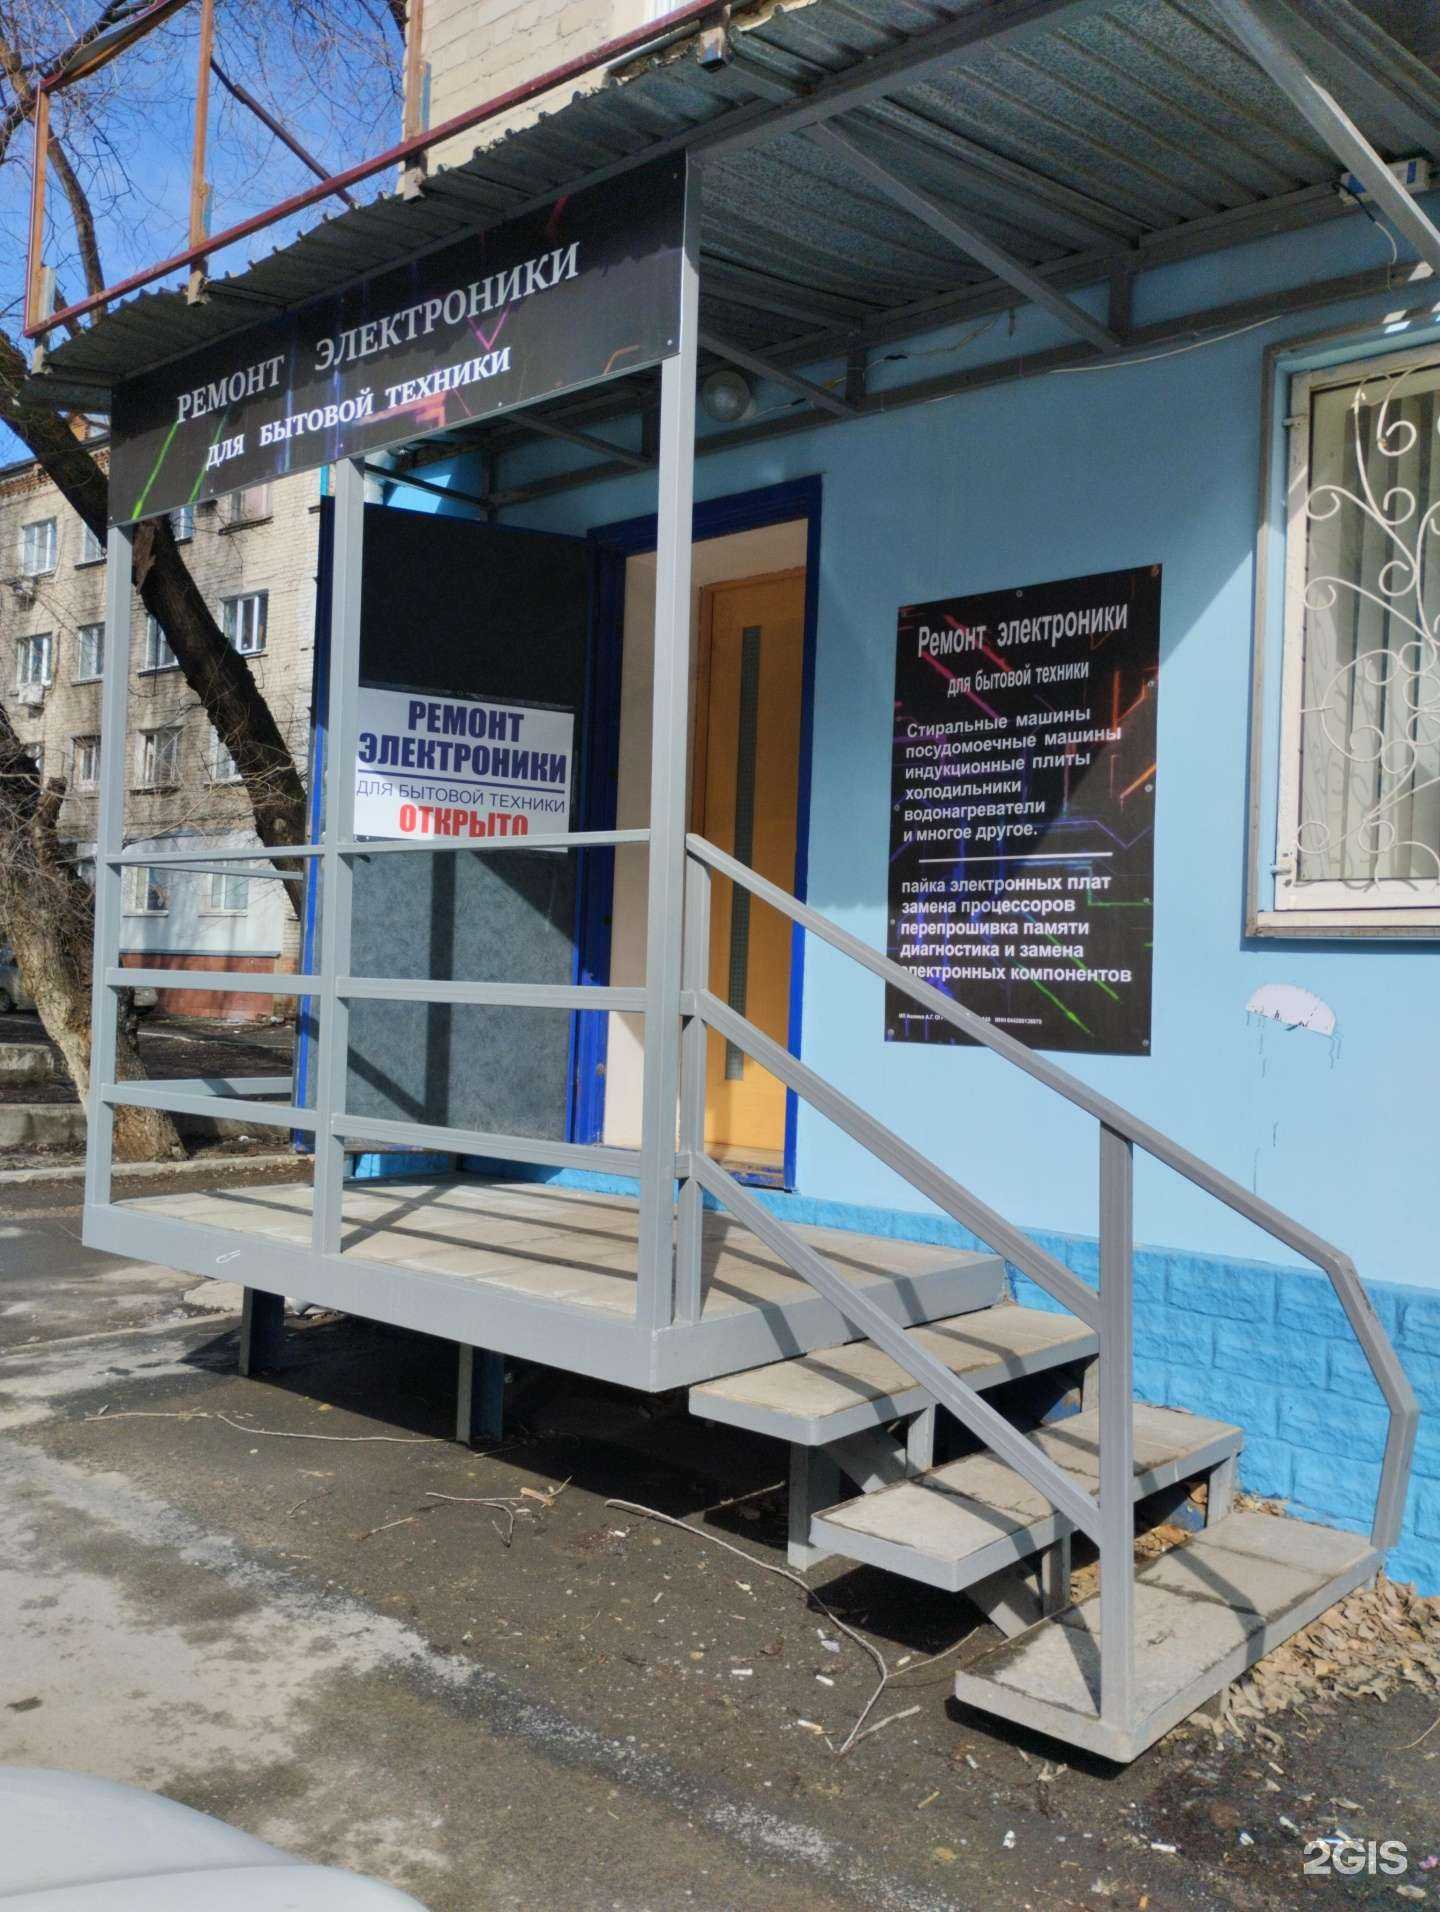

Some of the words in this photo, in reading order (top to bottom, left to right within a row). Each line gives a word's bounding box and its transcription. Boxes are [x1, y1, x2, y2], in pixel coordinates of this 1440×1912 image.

[176, 355, 284, 424] РЕМОНТ
[314, 242, 581, 371] ЭЛЕКТРОНИКИ
[260, 388, 373, 446] БЫТОВОЙ
[386, 347, 511, 409] ТЕХНИКИ
[918, 624, 987, 658] Ремонт
[997, 603, 1128, 647] электроники
[947, 677, 971, 697] для
[975, 664, 1031, 692] бытовой
[1036, 662, 1089, 683] техники
[408, 700, 524, 742] РЕМОНТ
[907, 715, 1008, 738] Стиральные
[1016, 706, 1091, 728] машины
[358, 732, 567, 784] ЭЛЕКТРОНИКИ
[906, 733, 1036, 759] посудомоечные
[1044, 727, 1121, 746] машины
[905, 757, 1025, 780] индукционные
[1032, 752, 1091, 769] плиты
[356, 780, 393, 796] ДЛЯ
[399, 784, 484, 804] БЫТОВОЙ
[489, 793, 565, 812] ТЕХНИКИ
[905, 779, 1021, 800] холодильники
[399, 804, 529, 838] ОТКРЫТО
[904, 800, 1046, 822] водонагреватели
[903, 830, 913, 842] и
[916, 826, 972, 841] многое
[976, 824, 1038, 844] другое.
[902, 878, 946, 893] пайка
[950, 876, 1062, 894] электронных
[1067, 875, 1112, 890] плат
[902, 901, 957, 914] замена
[961, 898, 1076, 916] процессоров
[901, 920, 1018, 938] перепрошивка
[1023, 921, 1089, 935] памяти
[900, 943, 1000, 958] диагностика
[1004, 944, 1014, 957] и
[1019, 944, 1084, 958] замена
[1010, 966, 1132, 982] компонентов
